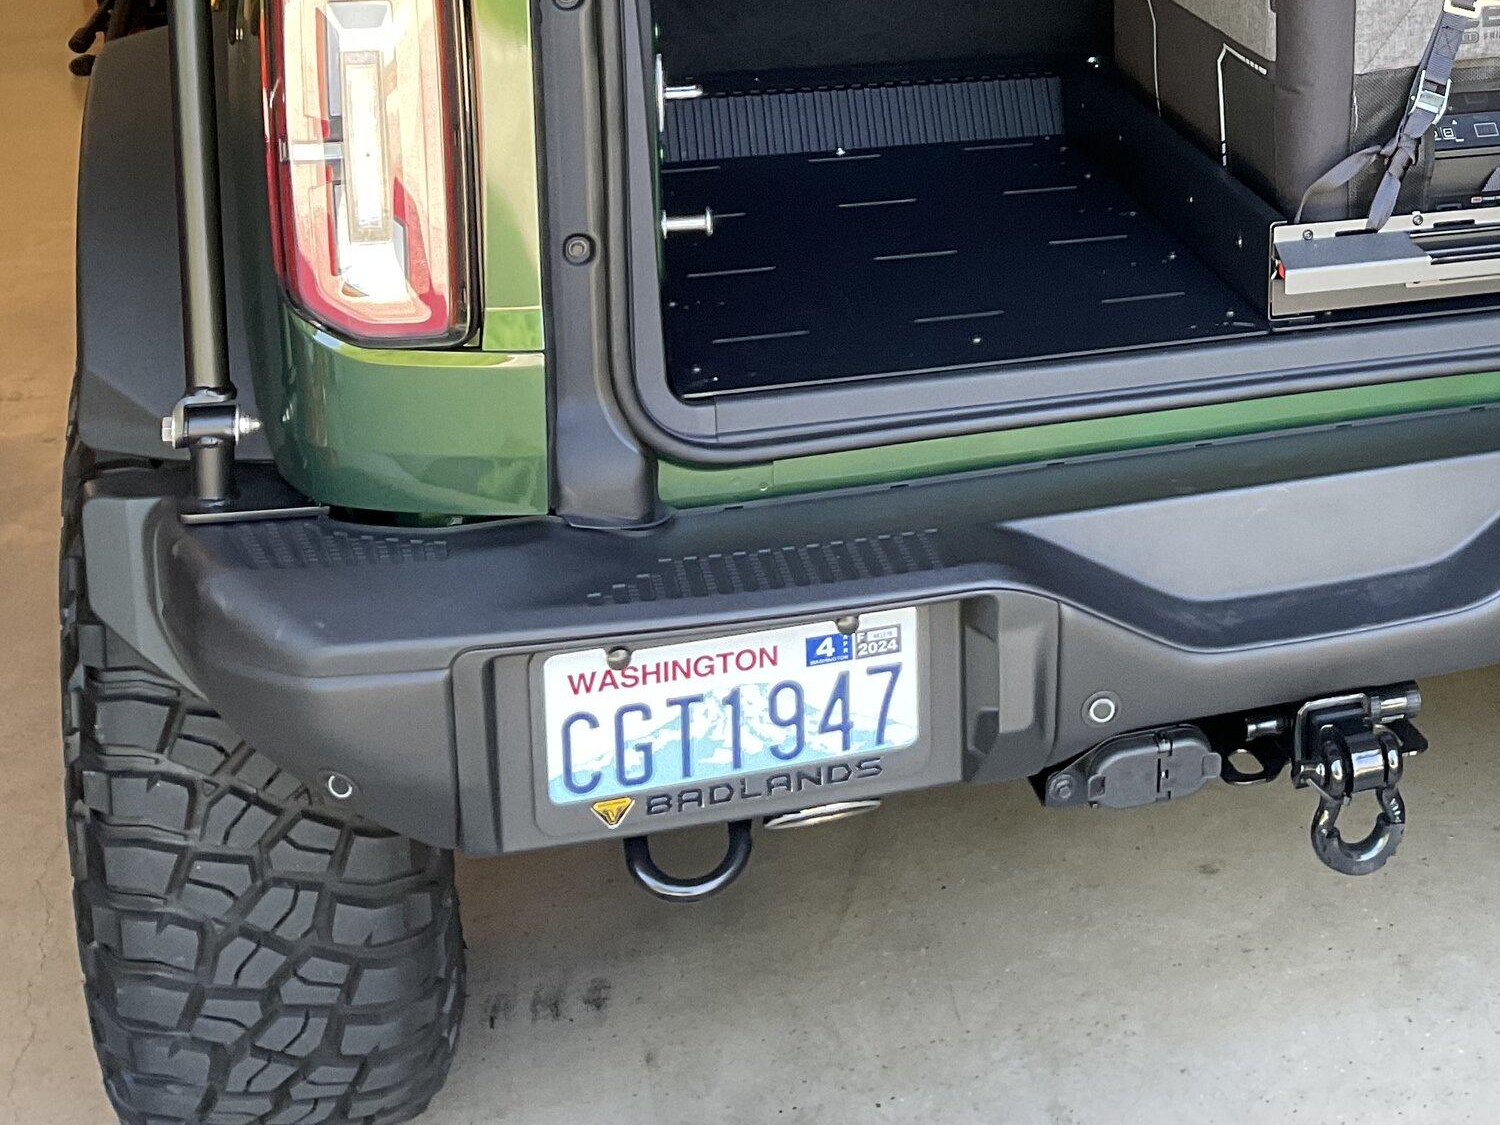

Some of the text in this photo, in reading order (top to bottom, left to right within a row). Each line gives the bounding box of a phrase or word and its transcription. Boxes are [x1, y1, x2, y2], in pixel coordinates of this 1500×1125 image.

[567, 644, 779, 696] WASHINGTON
[815, 636, 836, 658] 4
[857, 638, 899, 656] 2024
[560, 661, 904, 795] CGT1947
[645, 756, 885, 816] BADLANDS
